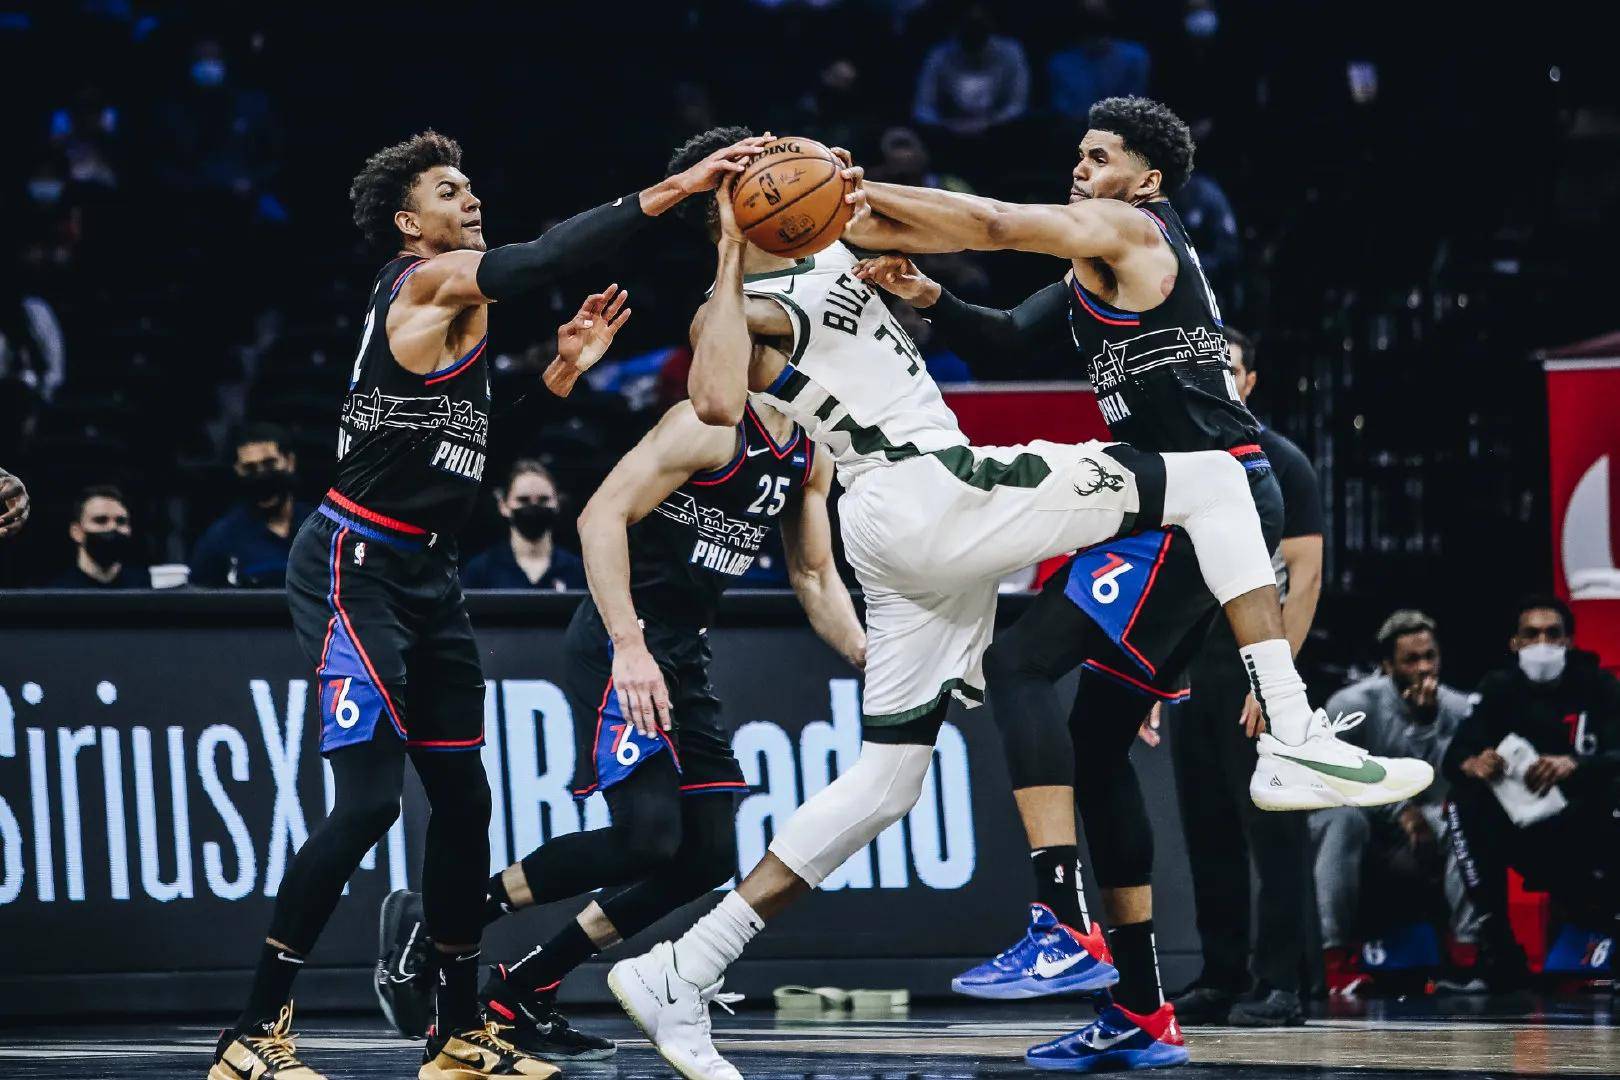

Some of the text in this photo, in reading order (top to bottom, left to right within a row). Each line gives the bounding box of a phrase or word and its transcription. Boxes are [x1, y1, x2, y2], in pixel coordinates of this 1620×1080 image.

[822, 272, 873, 336] BUC
[747, 474, 791, 516] 25
[1091, 552, 1134, 604] 76
[327, 677, 361, 729] 76
[609, 723, 641, 766] 76
[1561, 711, 1598, 756] 76
[0, 679, 409, 905] iriusX
